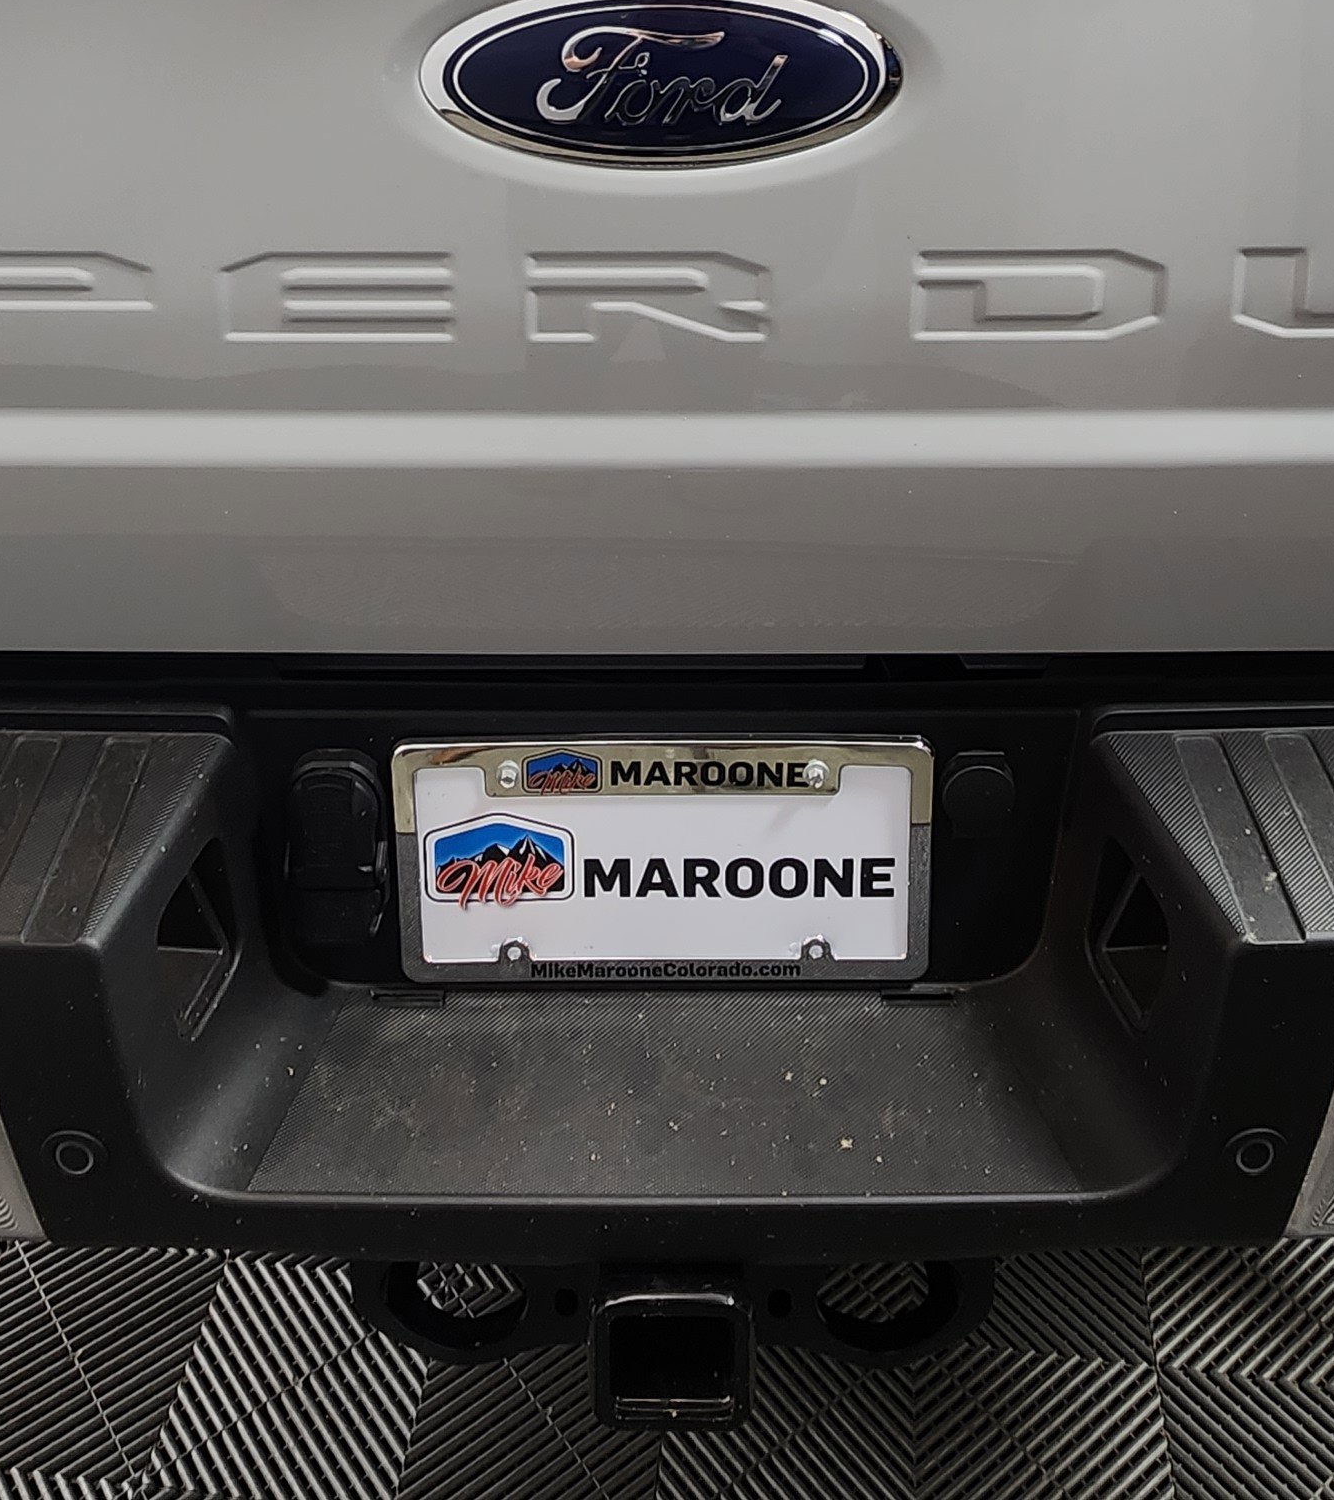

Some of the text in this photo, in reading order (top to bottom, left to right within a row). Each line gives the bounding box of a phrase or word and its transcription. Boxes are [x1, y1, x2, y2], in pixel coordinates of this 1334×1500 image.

[535, 25, 788, 126] Ford
[528, 760, 810, 796] Mike MAROONE
[435, 853, 896, 911] Mike MAROONE
[530, 961, 802, 979] MikeMarooneColorado.com
